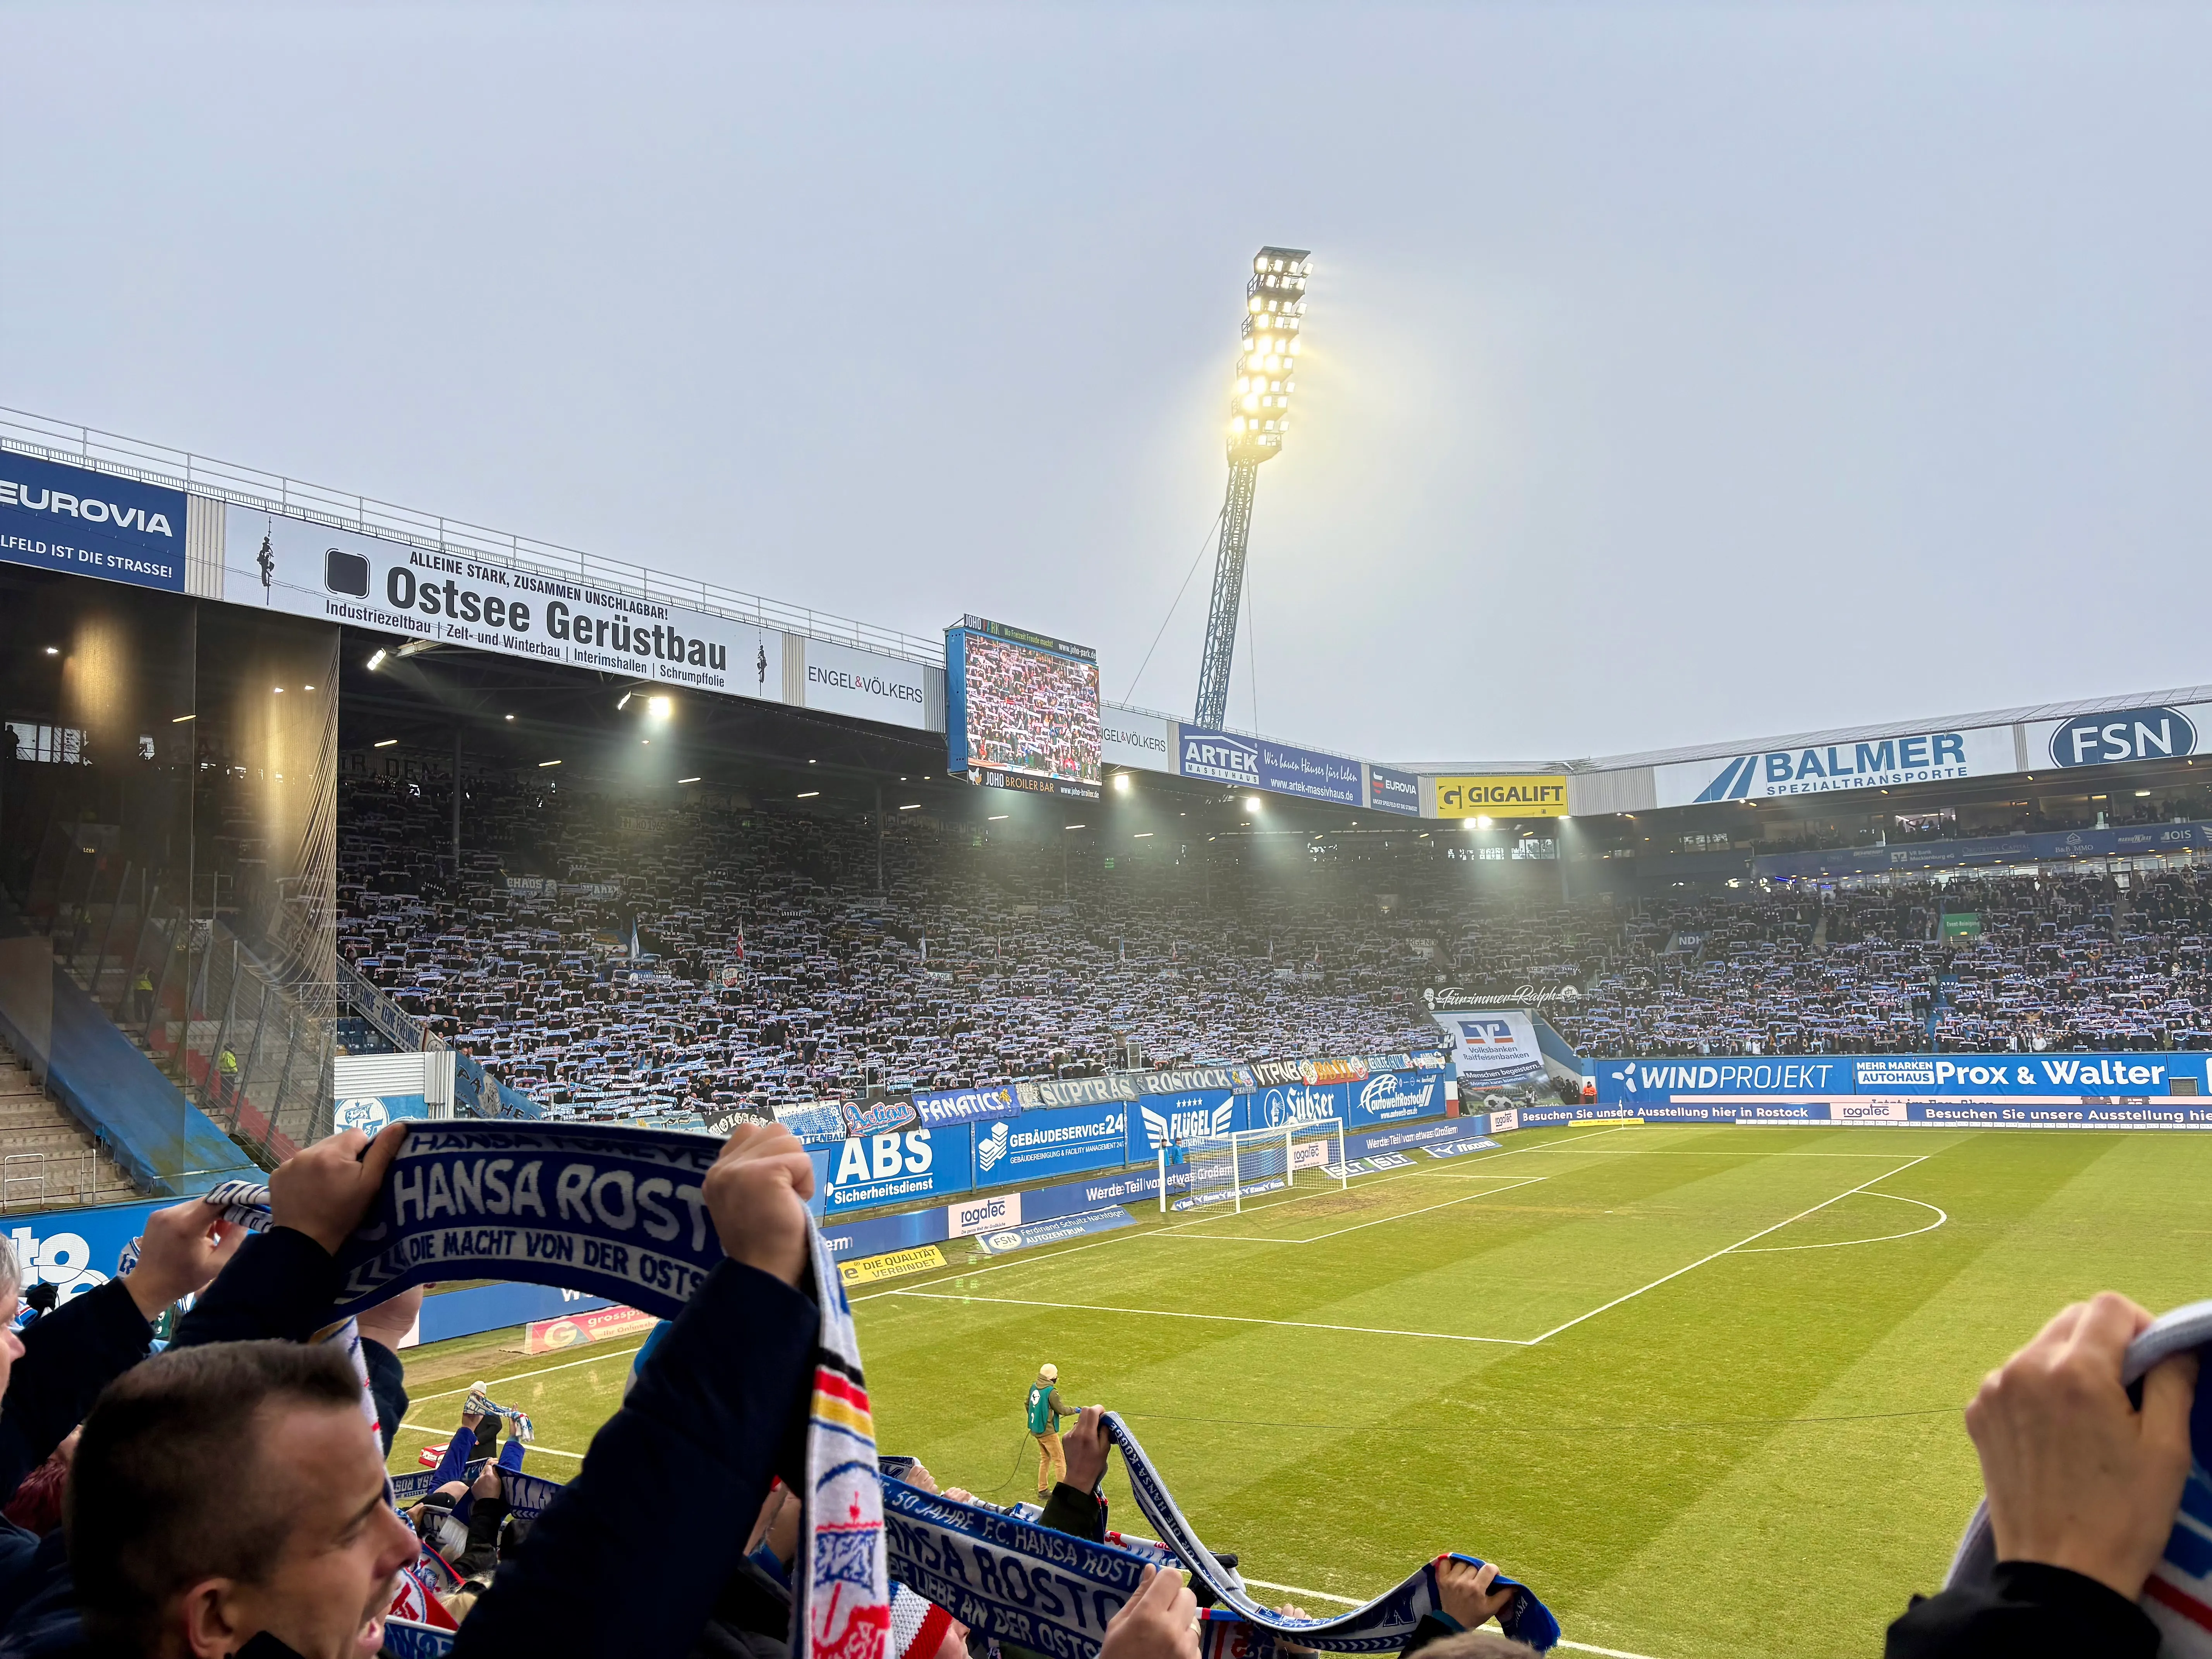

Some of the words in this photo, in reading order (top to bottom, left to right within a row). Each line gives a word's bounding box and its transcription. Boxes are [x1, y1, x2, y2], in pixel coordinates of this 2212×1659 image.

[0, 481, 172, 538] EUROVIA
[51, 545, 74, 560] IST
[79, 550, 103, 566] DIE
[107, 556, 173, 579] STRASSE!
[409, 551, 462, 575] ALLEINE
[467, 565, 510, 588] STARK,
[514, 575, 581, 602] ZUSAMMEN
[586, 592, 668, 620] UNSCHLAGBAR!
[386, 567, 531, 632] Ostsee
[546, 600, 727, 672] Gerüstbau
[326, 599, 431, 634] Industriezeltbau
[446, 624, 473, 640] Zelt-
[477, 632, 499, 646] und
[503, 635, 560, 658] Winterbau
[574, 648, 647, 673] Interimshallen
[659, 664, 725, 688] Schrumpffolie
[965, 614, 981, 630] JOHO
[983, 619, 1000, 635] PARK
[1004, 627, 1011, 636] Wo
[1012, 629, 1026, 641] Freizeit
[1027, 634, 1040, 644] Freude
[1040, 637, 1053, 648] macht!
[1058, 642, 1096, 659] www.joho-park.de
[808, 666, 923, 704] ENGEL&VÖLKERS
[2071, 718, 2173, 764] FSN
[1186, 742, 1259, 773] ARTEK
[1264, 749, 1278, 767] Wir
[1280, 753, 1300, 771] bauen
[1301, 757, 1324, 776] Häuser
[1325, 766, 1339, 782] fürs
[1340, 766, 1357, 782] Leben
[1765, 733, 1966, 783] BALMER
[986, 771, 1004, 788] JOHO
[1006, 776, 1038, 791] BROILER
[1040, 781, 1055, 793] BAR
[1188, 763, 1257, 783] MASSIVHAUS
[1766, 766, 1968, 796] SPEZIALTRANSPORTE
[1271, 778, 1353, 801] www.artek-massivhaus.de
[1386, 780, 1417, 795] EUROVIA
[1468, 785, 1564, 804] GIGALIFT
[507, 877, 543, 889] CHAOS
[1513, 985, 1557, 1008] Ralph
[1463, 1052, 1529, 1061] Raiffeisenbanken
[1857, 1062, 1886, 1070] MEHR
[1888, 1061, 1934, 1070] MARKEN
[1145, 1066, 1232, 1094] ROSTOCK
[1251, 1061, 1302, 1085] VTPNB
[1465, 1070, 1499, 1079] Menschen
[1501, 1064, 1540, 1076] begeistern.
[1641, 1065, 1833, 1089] WINDPROJEKT
[1862, 1071, 1930, 1082] AUTOHAUS
[1938, 1061, 2009, 1085] Prox
[2018, 1065, 2035, 1084] &
[2041, 1060, 2166, 1085] Walter
[1040, 1078, 1136, 1106] SUPTRAS
[1371, 1088, 1423, 1110] autoweltRostock
[845, 1103, 912, 1128] Action
[917, 1092, 1004, 1122] FANATICS
[1523, 1111, 1572, 1121] Besuchen
[1576, 1110, 1593, 1118] Sie
[1597, 1108, 1634, 1118] unsere
[1638, 1106, 1708, 1120] Ausstellung
[1712, 1106, 1736, 1117] hier
[1740, 1106, 1752, 1116] in
[1757, 1106, 1808, 1117] Rostock
[1843, 1104, 1890, 1118] rogatec
[1926, 1108, 1997, 1119] Besuchen
[2002, 1108, 2025, 1119] Sie
[2030, 1110, 2083, 1120] unsere
[2088, 1109, 2184, 1122] Ausstellung
[1170, 1109, 1211, 1139] FLÜGEL
[835, 1128, 933, 1185] ABS
[1010, 1149, 1061, 1164] GEBÄUDEREINIGUNG
[1065, 1146, 1085, 1156] FACILITY
[1085, 1142, 1115, 1153] MANAGEMENT
[1294, 1145, 1319, 1163] rogatec
[1373, 1154, 1408, 1166] SLT
[835, 1177, 933, 1204] Sicherheitsdienst
[1085, 1183, 1125, 1201] Werde
[393, 1158, 545, 1226] HANSA
[556, 1163, 710, 1250] ROST
[961, 1199, 1005, 1227] rogatec
[1020, 1222, 1058, 1237] Ferdinand
[1060, 1218, 1086, 1230] Schultz
[1087, 1209, 1125, 1223] Nachfolger
[1026, 1226, 1086, 1244] AUTOZENTRUM
[409, 1235, 436, 1261] DIE
[443, 1230, 514, 1257] MACHT
[526, 1231, 574, 1261] VON
[584, 1242, 628, 1275] DER
[994, 1235, 1017, 1245] FSN
[863, 1260, 883, 1270] DIE
[885, 1249, 936, 1266] QUALITÄT
[872, 1259, 936, 1278] VERBINDET
[1109, 1422, 1166, 1512] HANSA-KOGGE
[1165, 1512, 1182, 1537] DIE
[918, 1501, 974, 1532] JAHRE
[1015, 1525, 1078, 1570] HANSA
[1083, 1553, 1140, 1587] ROST
[917, 1569, 956, 1614] LIEBE
[960, 1593, 987, 1627] AN
[994, 1607, 1034, 1645] DER
